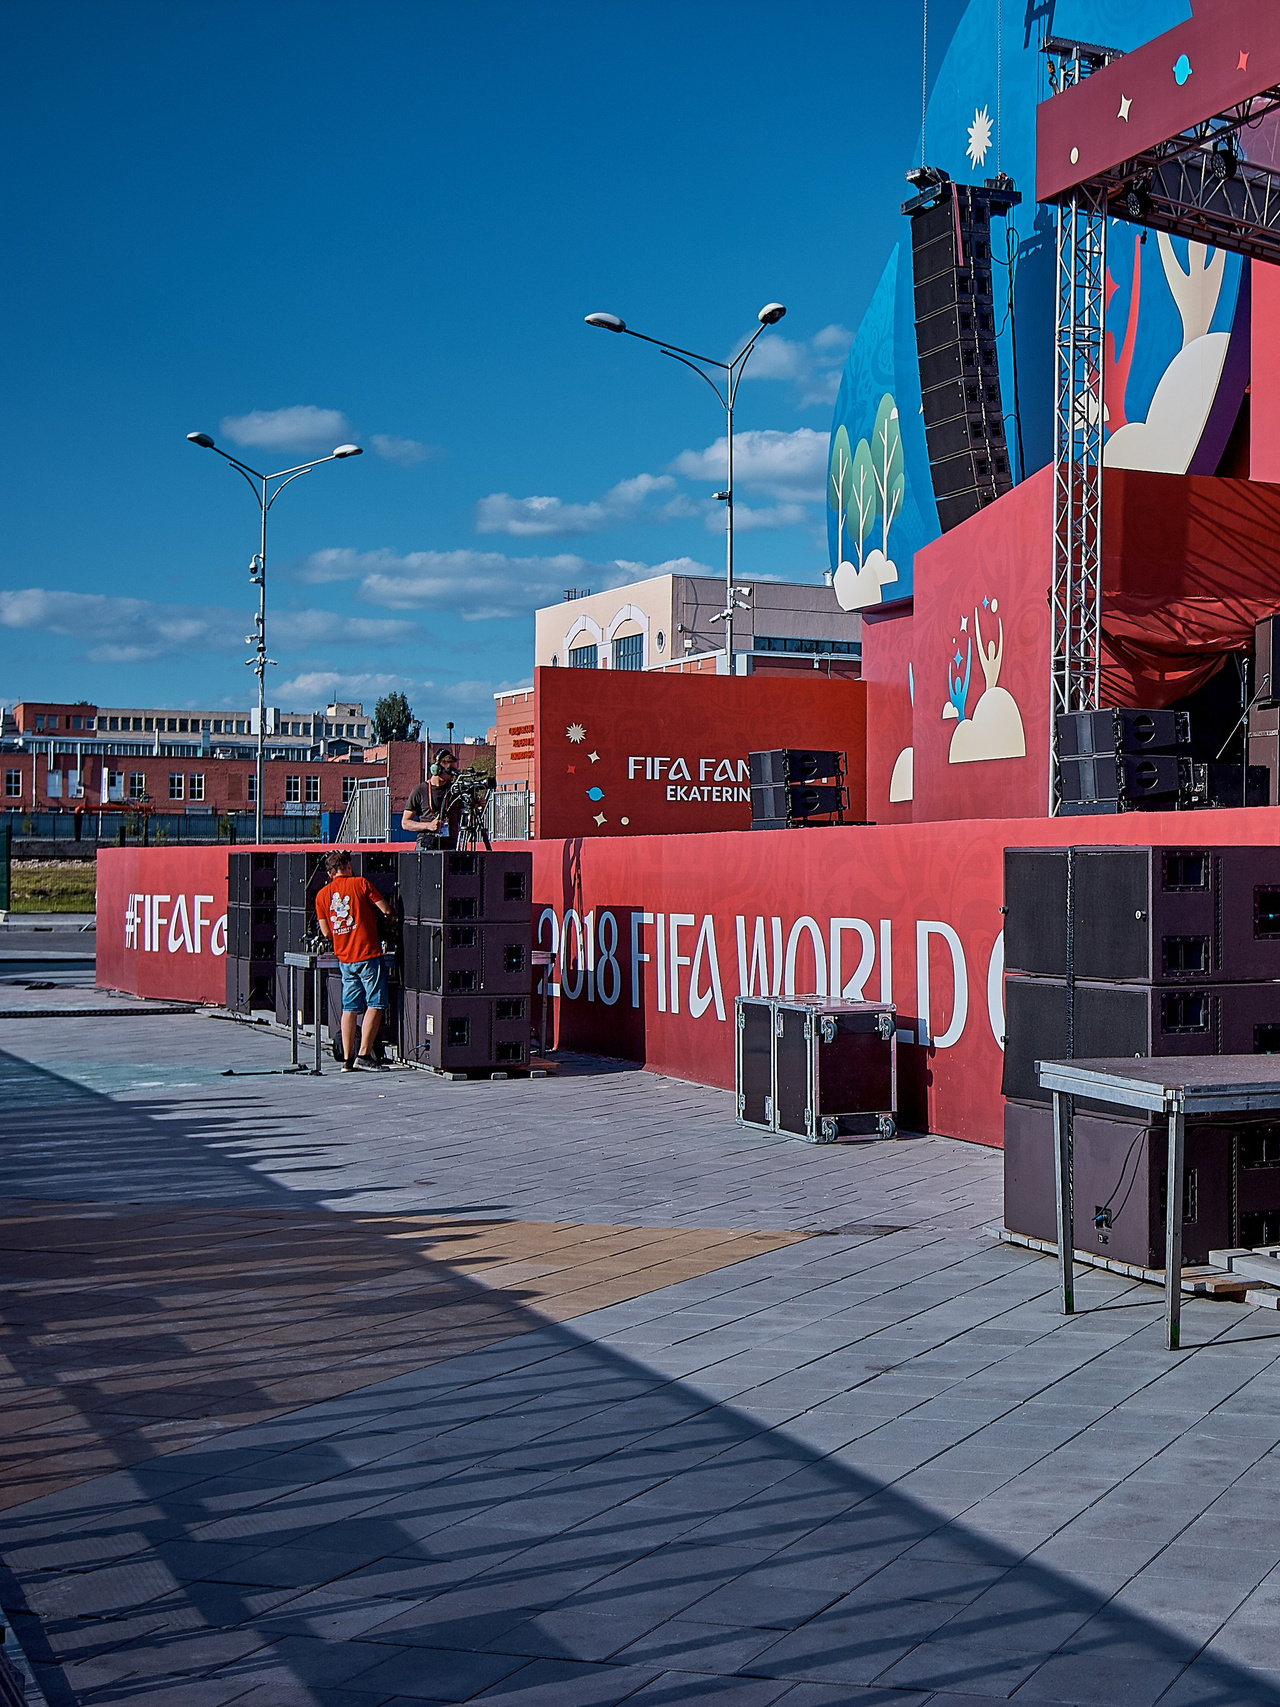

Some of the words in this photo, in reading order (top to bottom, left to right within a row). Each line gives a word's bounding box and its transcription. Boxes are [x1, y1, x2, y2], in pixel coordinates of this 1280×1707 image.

[628, 756, 692, 781] FIFA
[538, 907, 621, 1006] 2018
[631, 911, 727, 1021] FIFA
[735, 914, 969, 1049] WORLD
